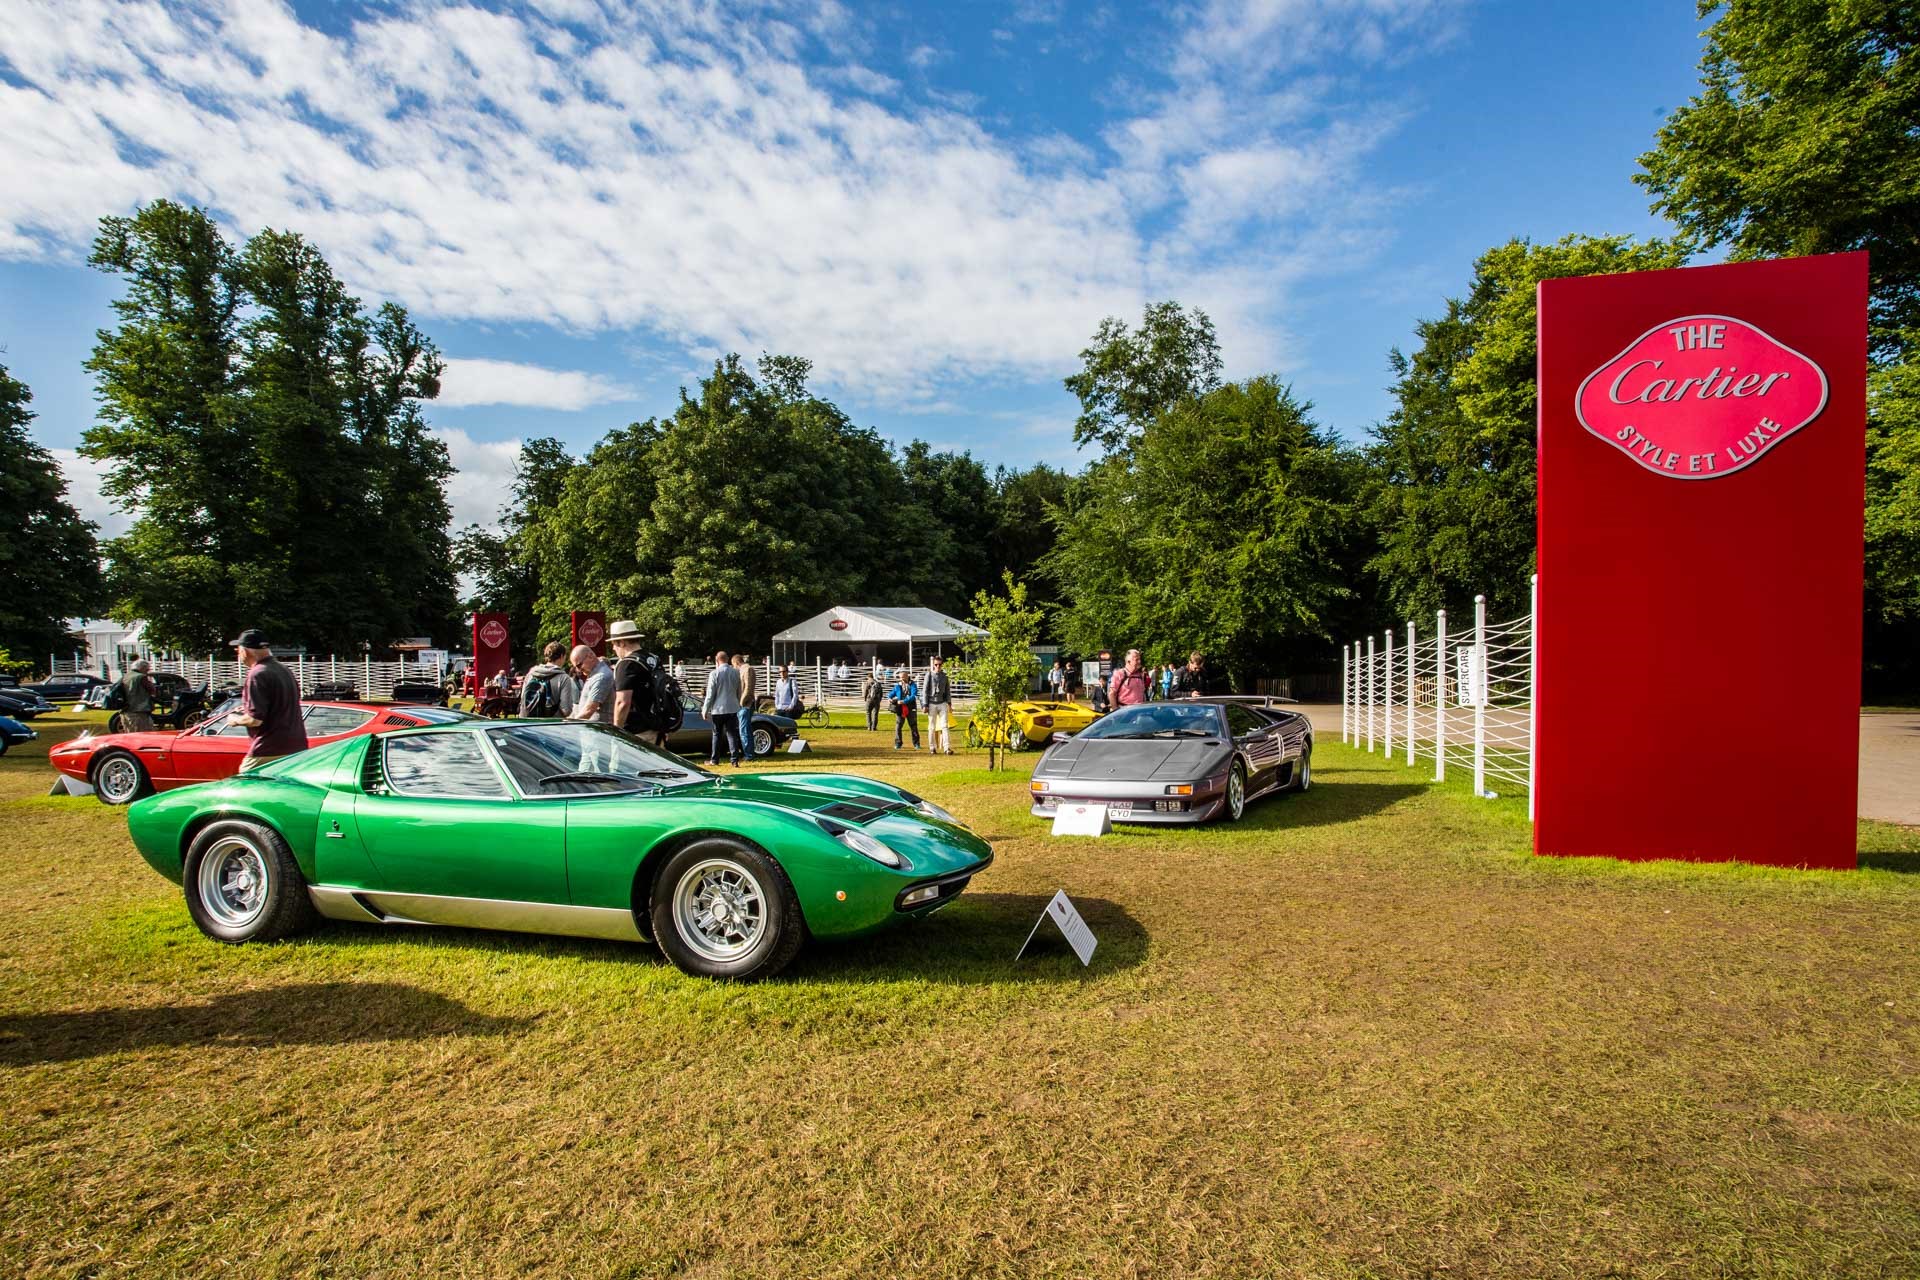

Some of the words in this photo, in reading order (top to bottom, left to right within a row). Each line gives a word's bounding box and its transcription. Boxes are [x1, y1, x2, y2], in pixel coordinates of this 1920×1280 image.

[1669, 324, 1727, 351] THE
[1608, 359, 1790, 404] Cartier
[1616, 425, 1680, 470] STYLE
[1689, 453, 1716, 472] ET
[1726, 416, 1781, 462] LUXE
